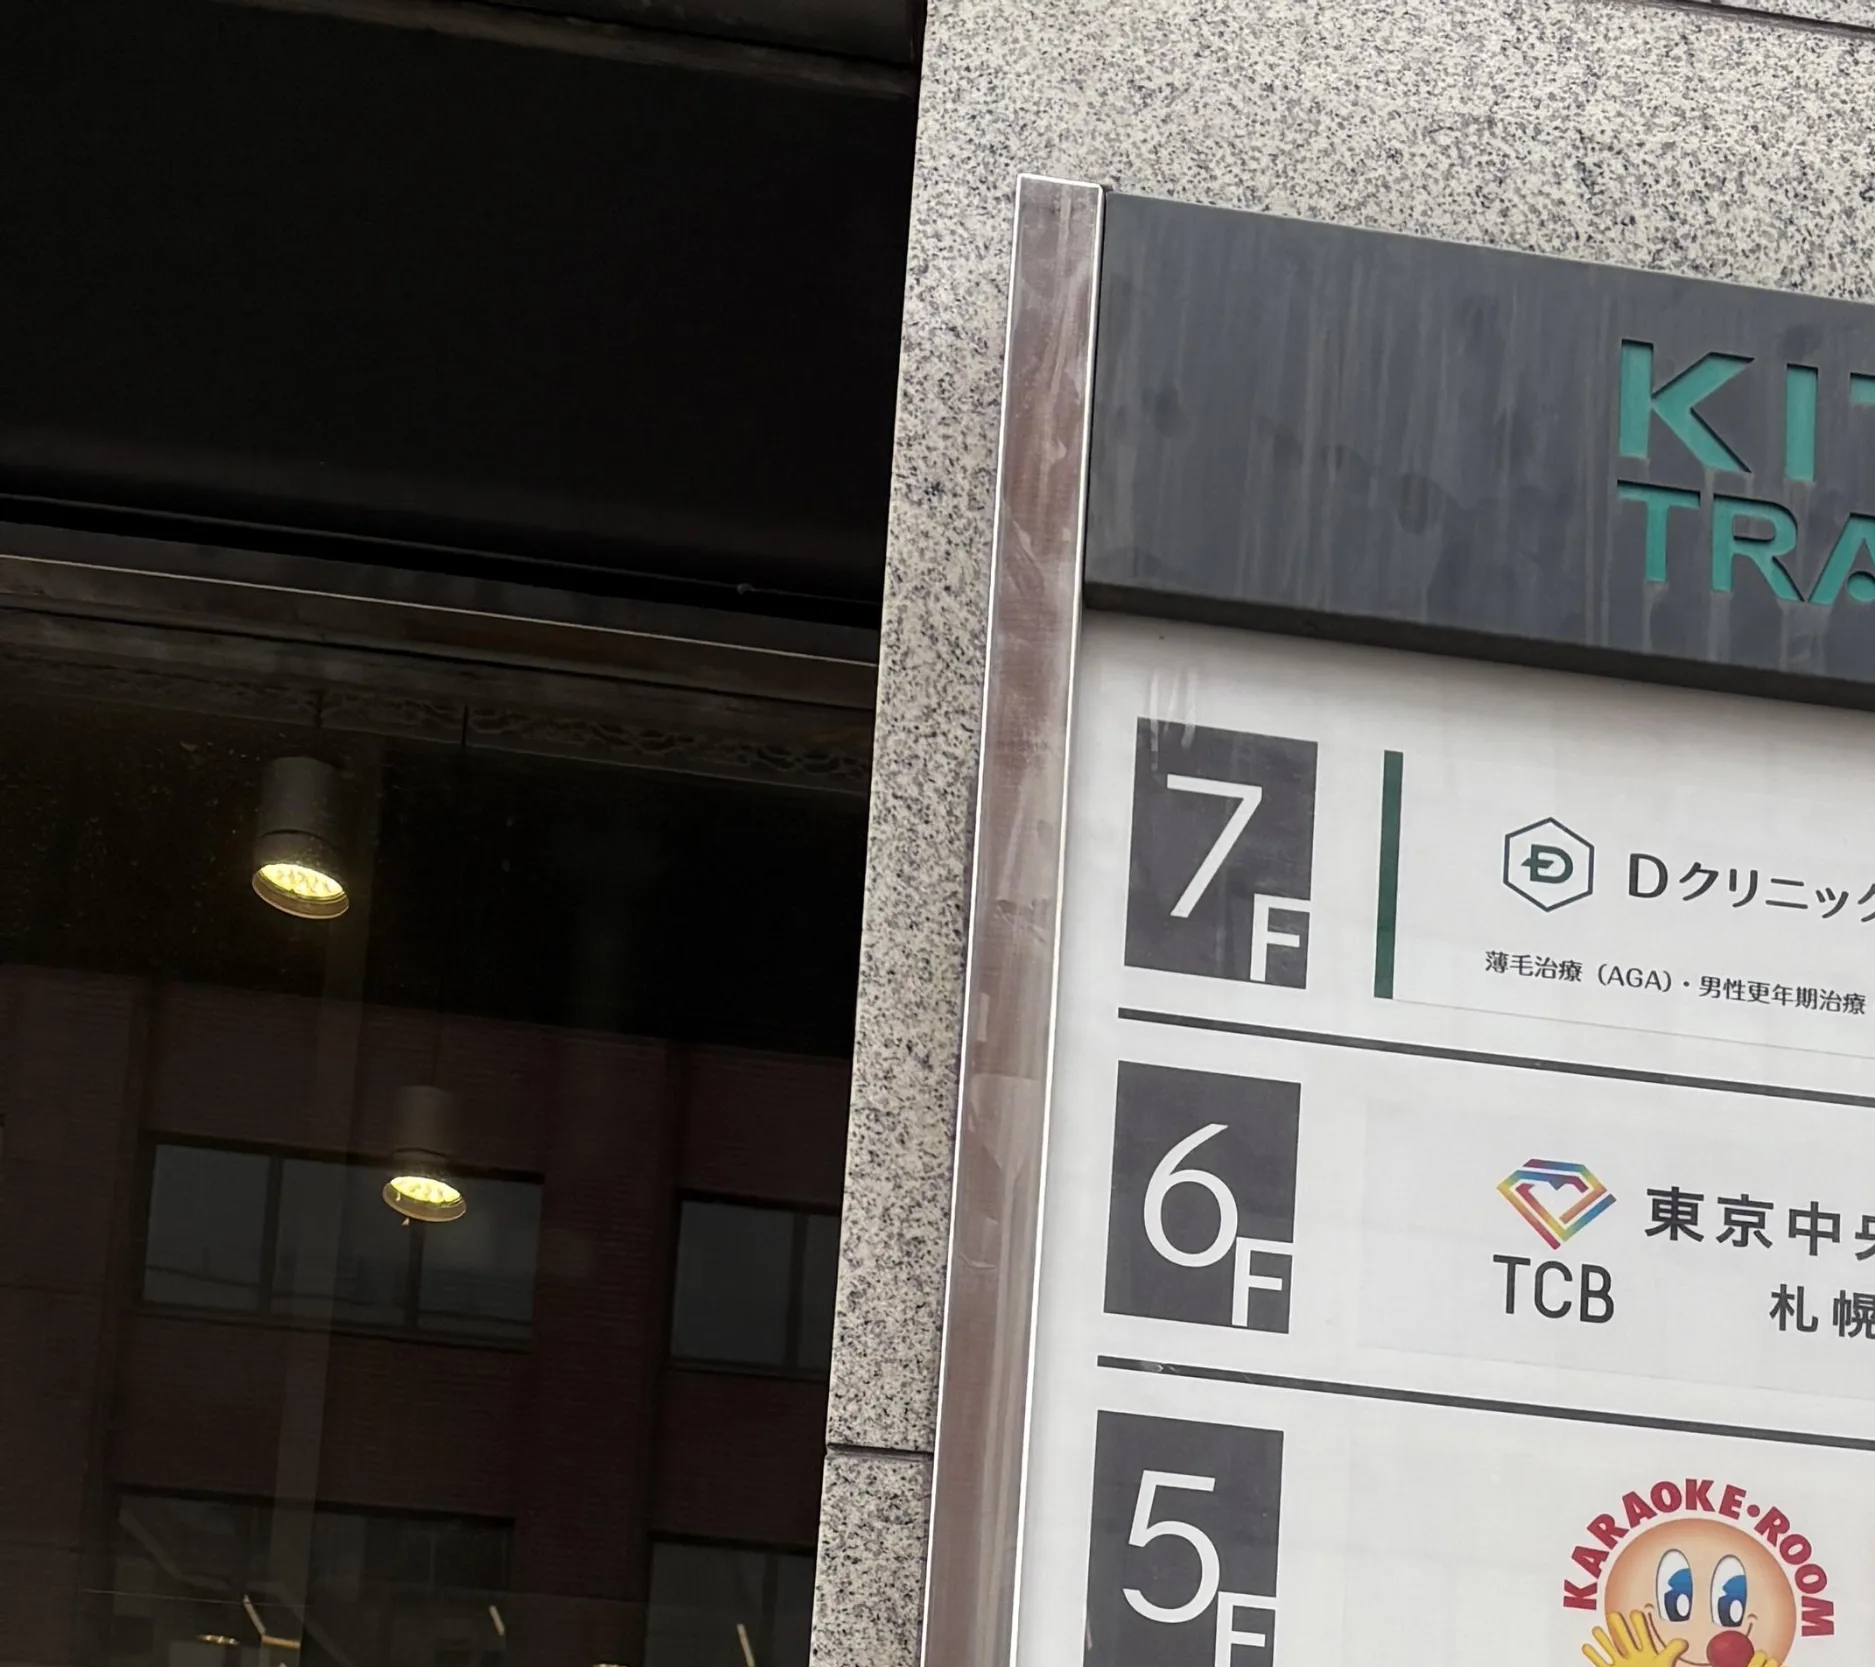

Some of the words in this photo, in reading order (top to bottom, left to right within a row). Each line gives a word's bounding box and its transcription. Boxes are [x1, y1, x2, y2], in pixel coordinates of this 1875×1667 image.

[1166, 773, 1311, 983] 7F
[1143, 1122, 1295, 1327] 6F
[1492, 1255, 1615, 1324] TCB
